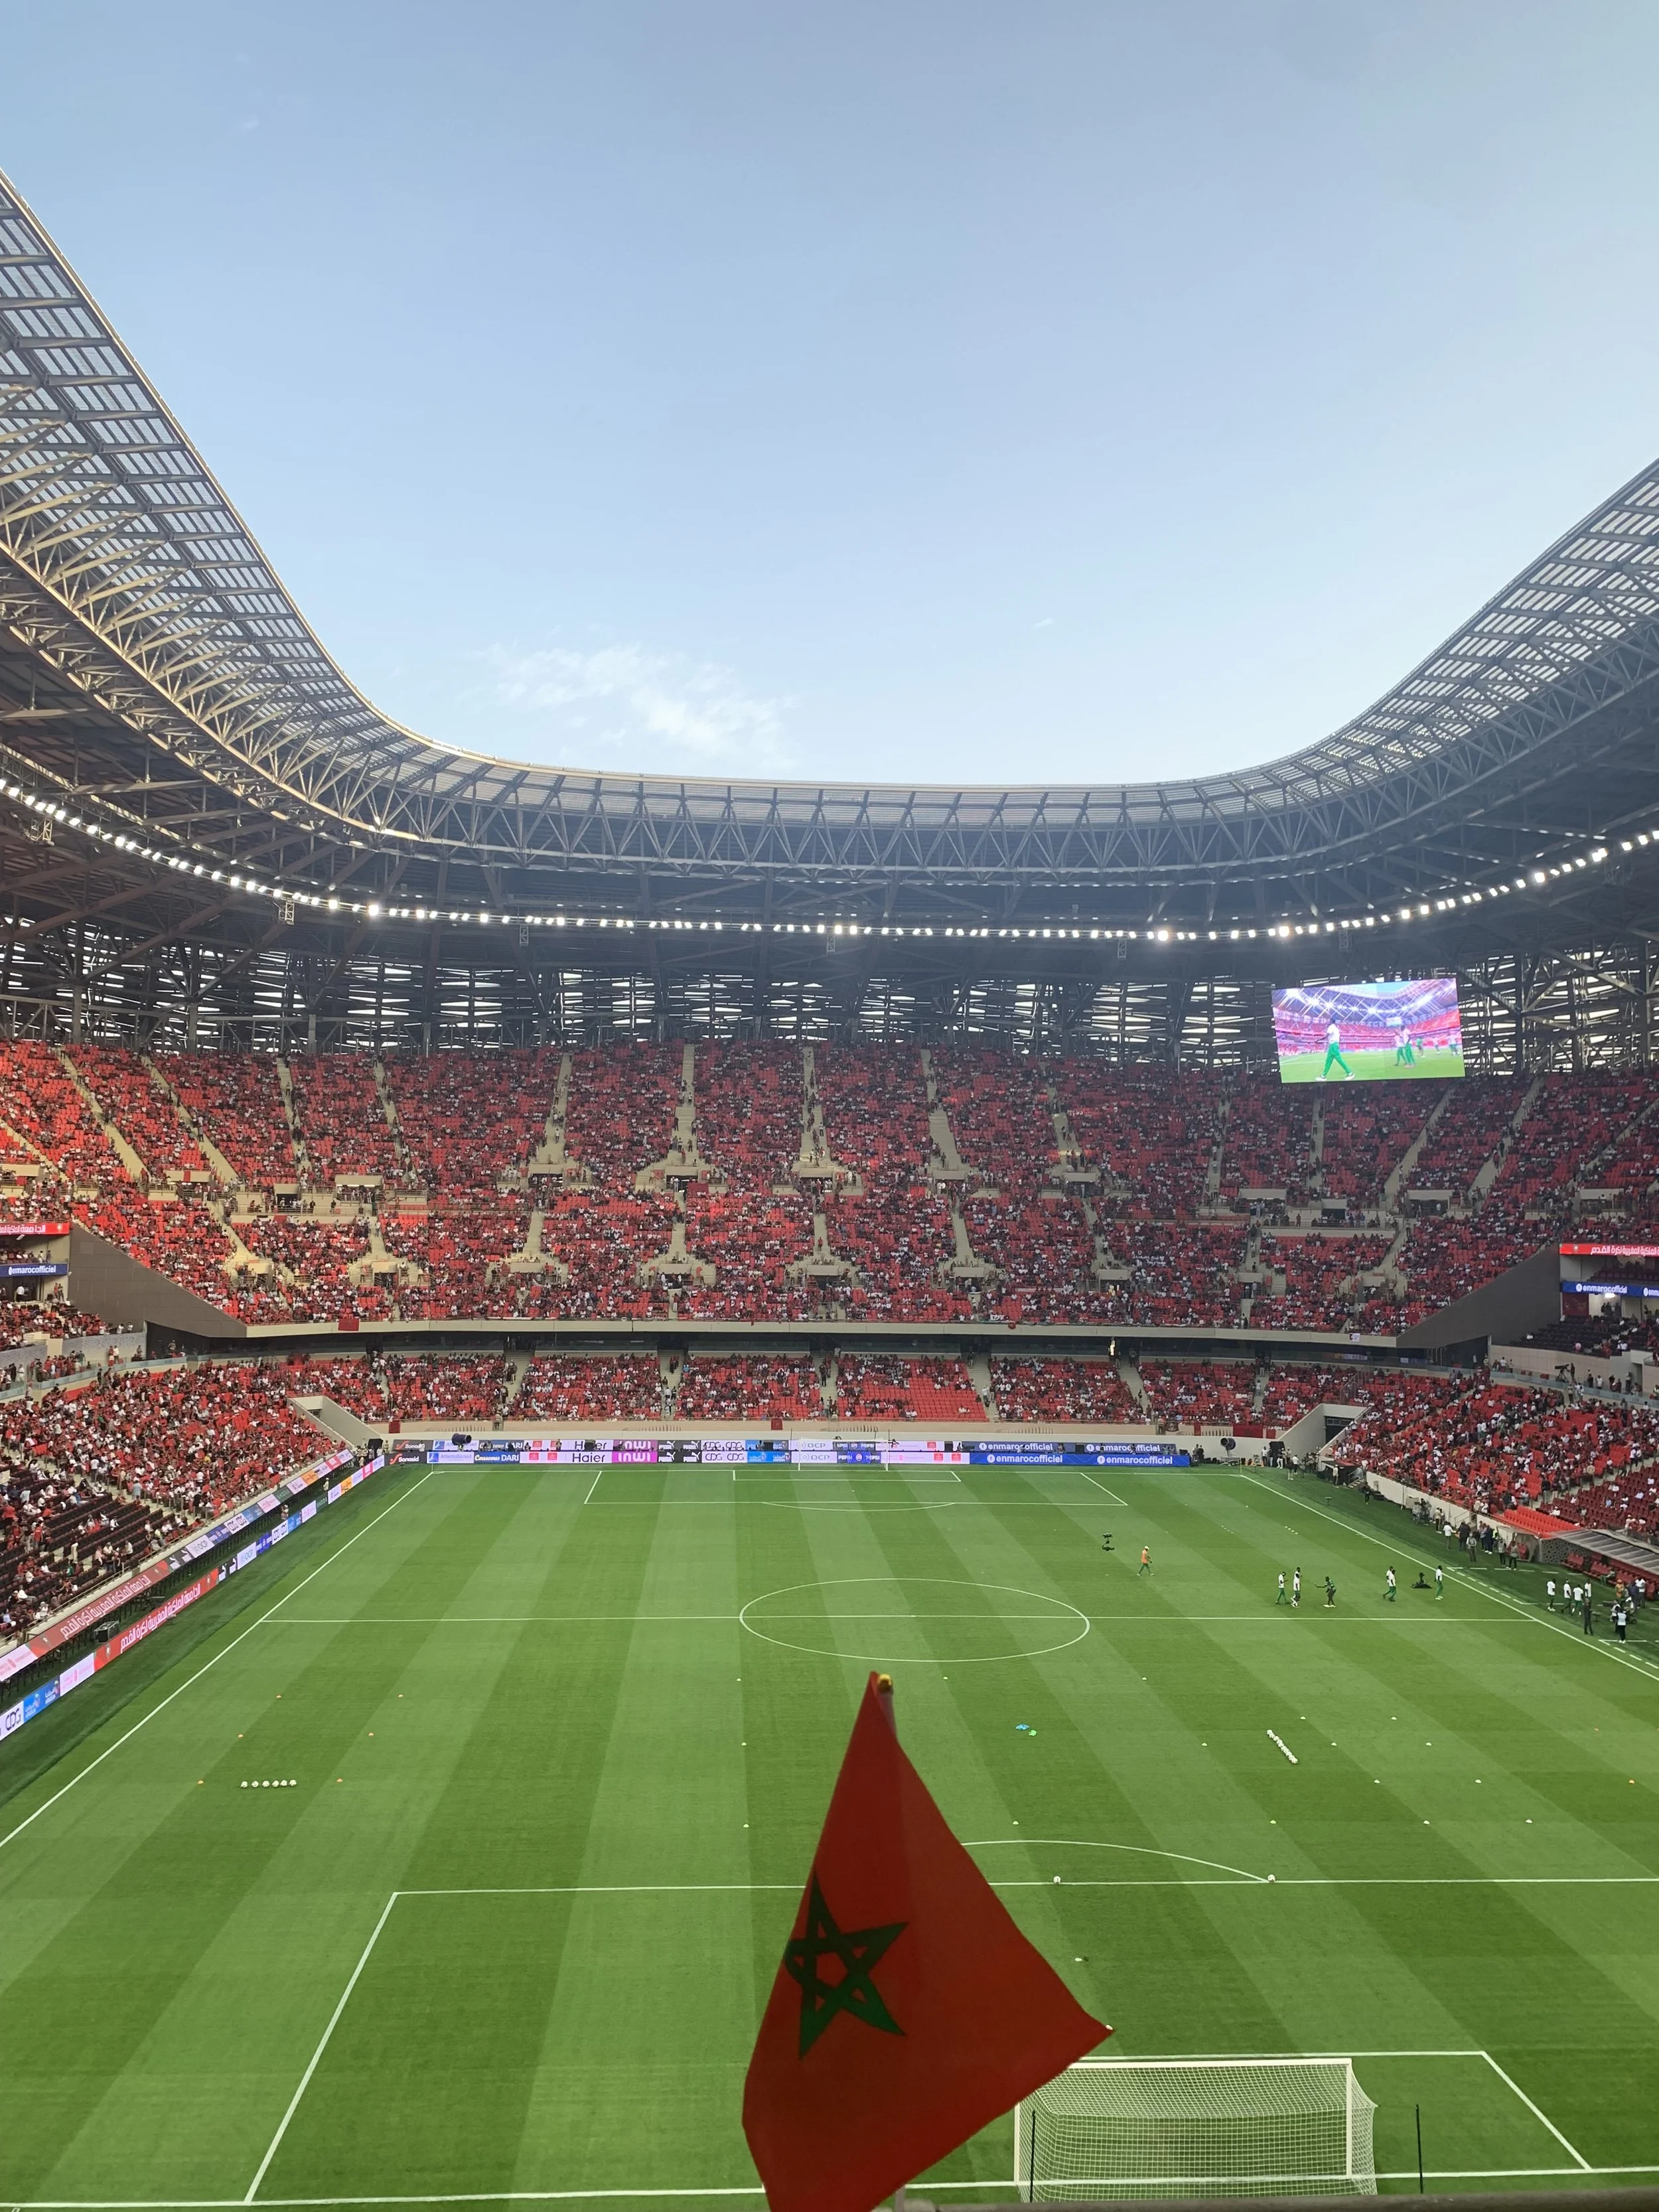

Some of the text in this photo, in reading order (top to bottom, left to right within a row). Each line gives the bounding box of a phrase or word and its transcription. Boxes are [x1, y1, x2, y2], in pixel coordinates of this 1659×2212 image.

[575, 1441, 607, 1449] Her
[572, 1452, 605, 1463] Haier
[996, 1455, 1062, 1463] enmarocofficiel
[1106, 1456, 1173, 1465] enmarocofficiel
[5, 1708, 21, 1731] CDG
